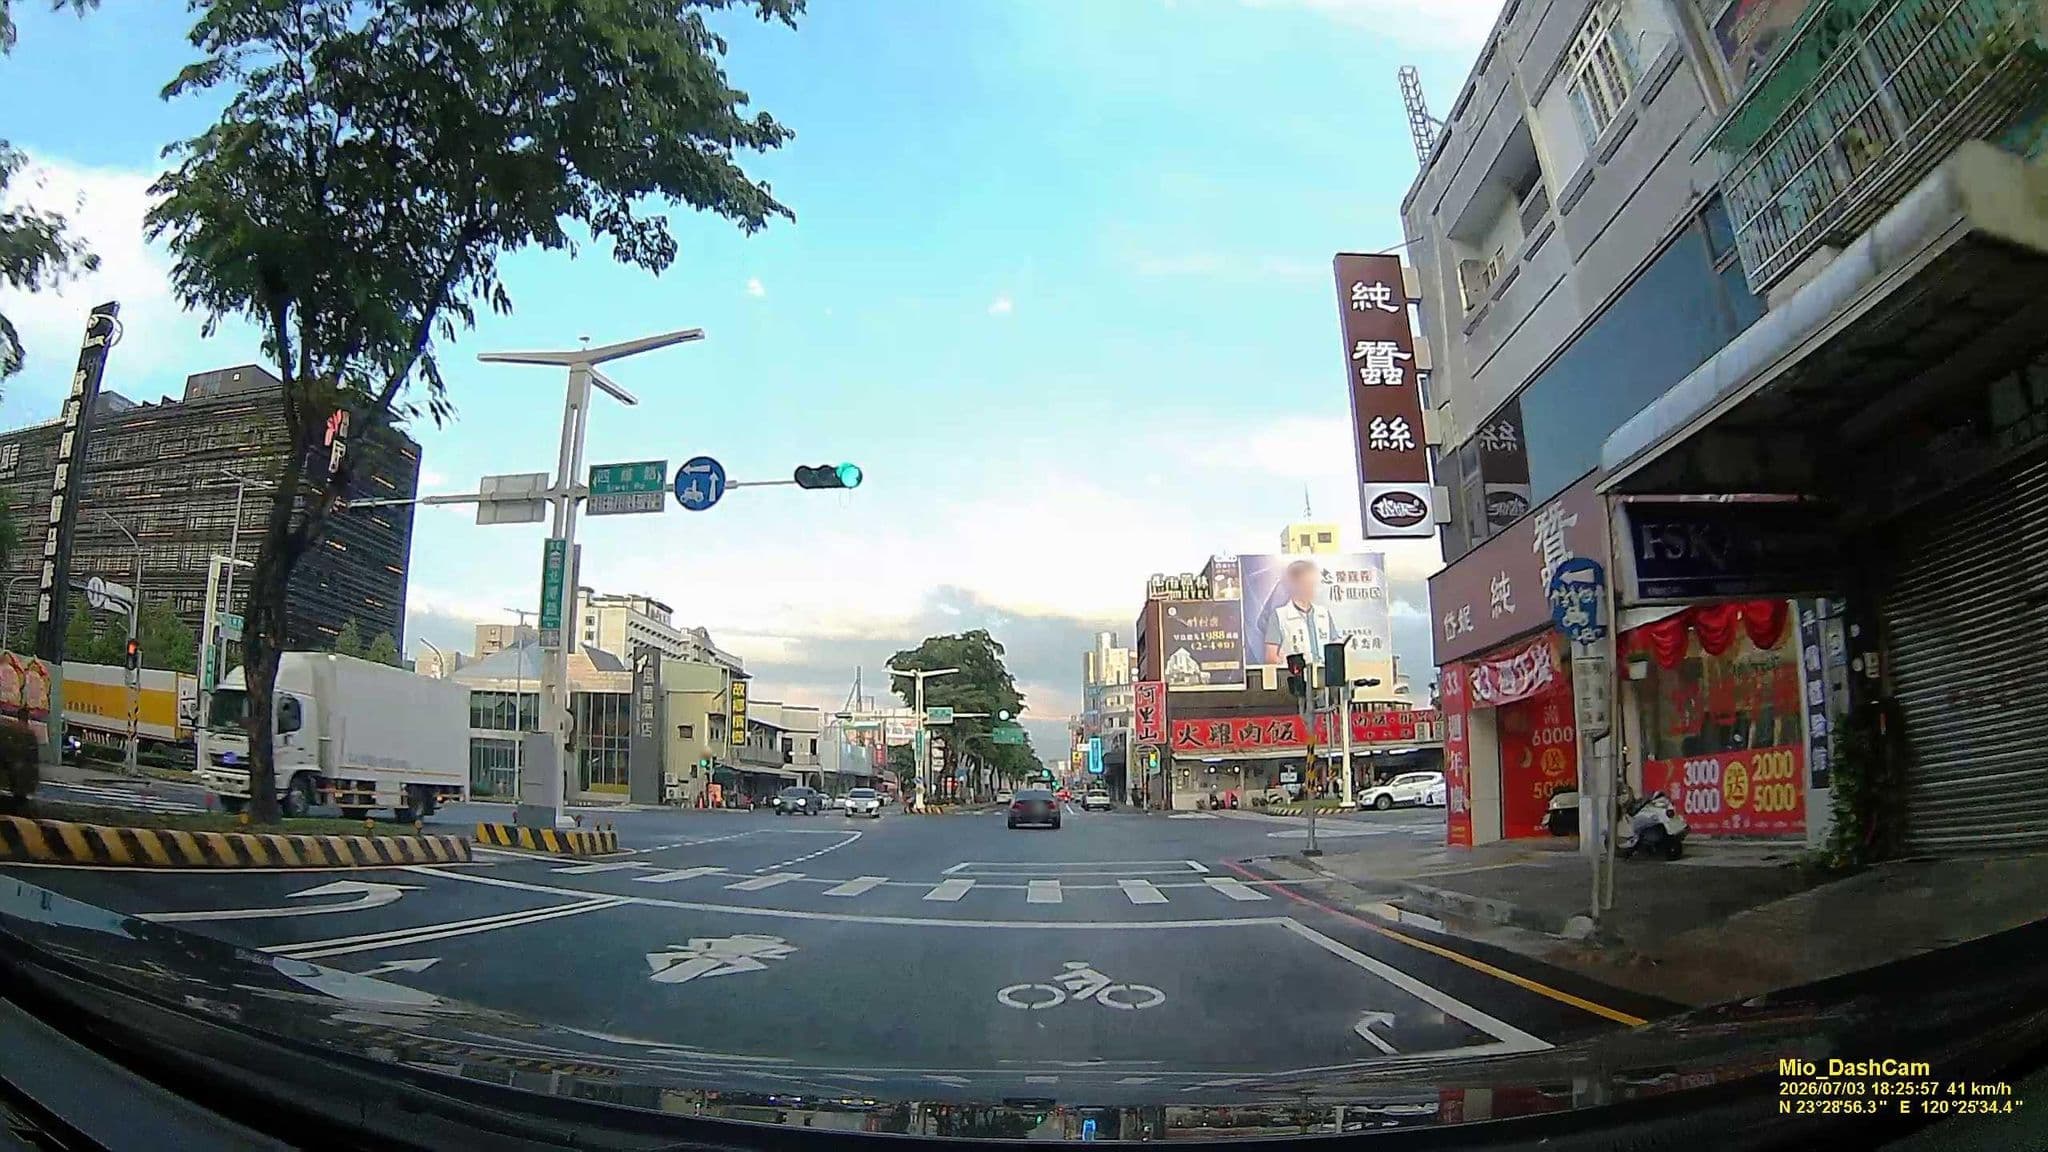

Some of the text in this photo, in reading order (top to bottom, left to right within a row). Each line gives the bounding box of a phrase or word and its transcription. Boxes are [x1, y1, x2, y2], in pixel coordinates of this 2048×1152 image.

[1177, 719, 1299, 747] 火雞肉飯
[1532, 726, 1575, 747] 6000
[1683, 749, 1794, 787] 3000 2000
[1684, 782, 1797, 814] 6000 5000
